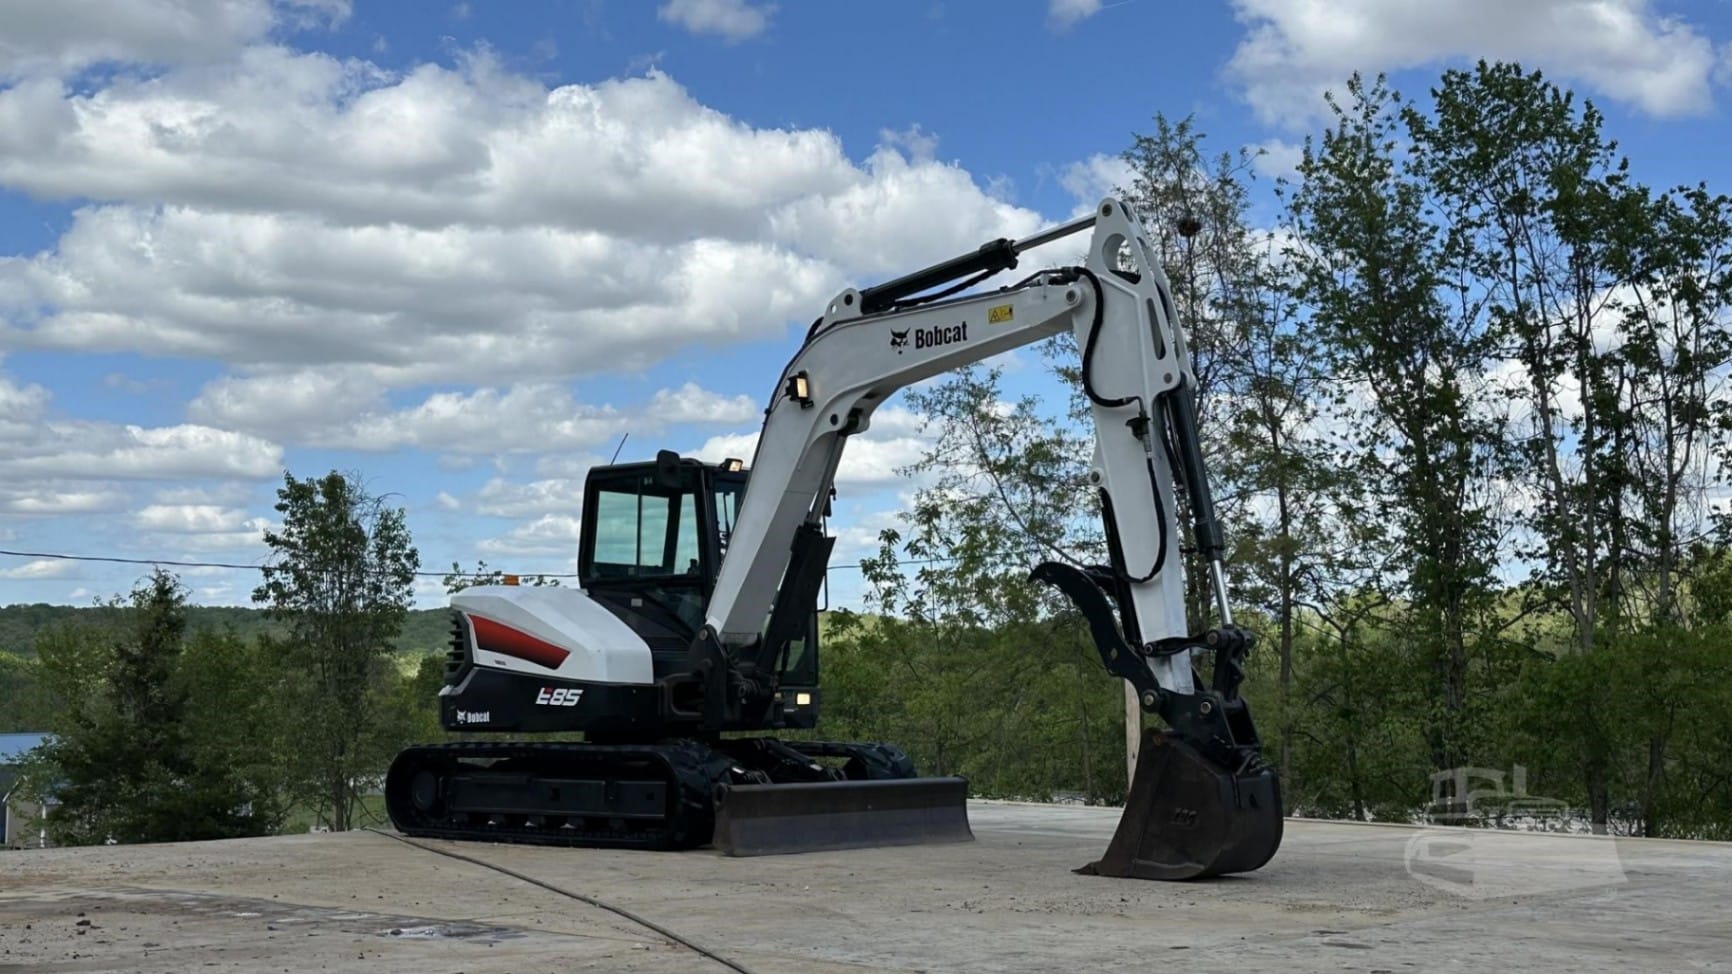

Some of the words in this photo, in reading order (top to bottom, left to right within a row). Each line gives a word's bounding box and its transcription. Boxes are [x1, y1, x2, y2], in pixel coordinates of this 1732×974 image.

[914, 320, 968, 350] Bobcat
[535, 687, 584, 706] E85
[467, 711, 490, 724] Bobcat
